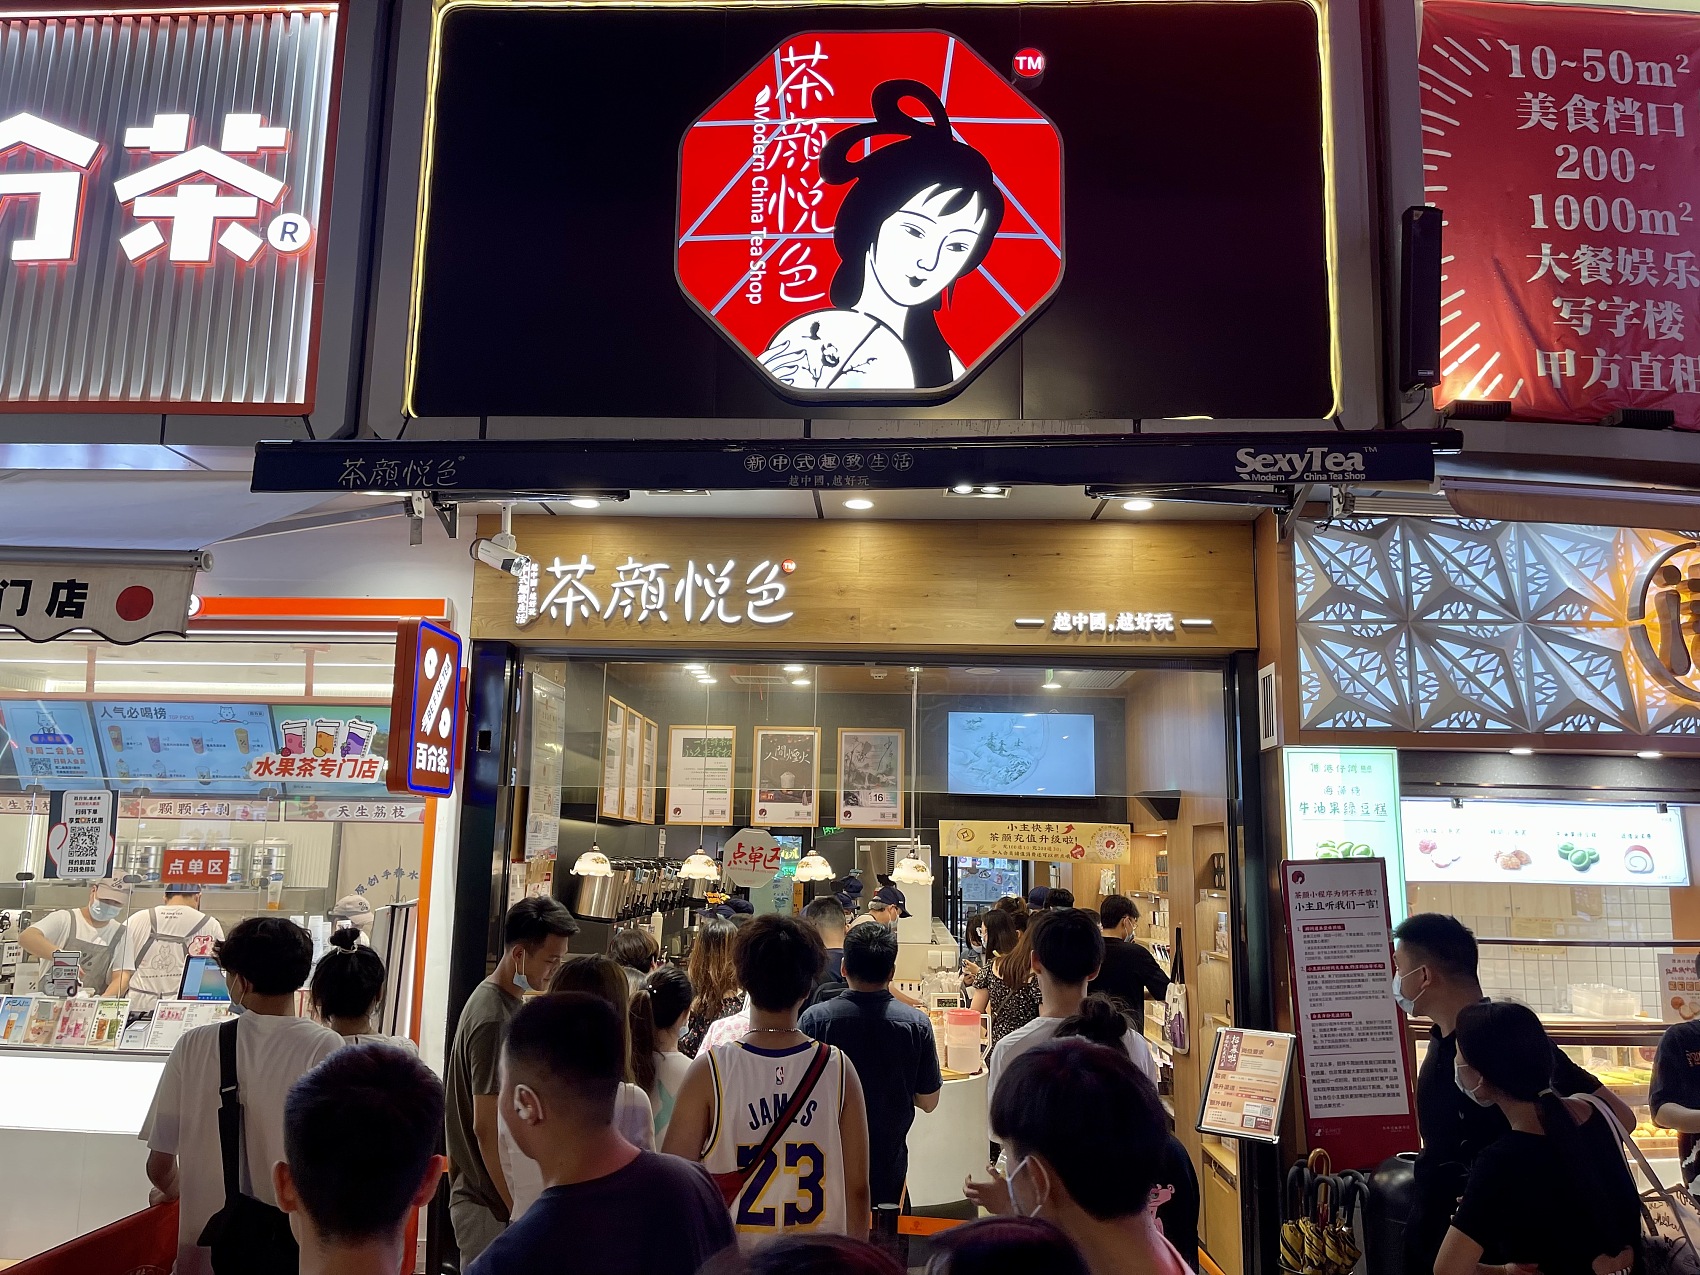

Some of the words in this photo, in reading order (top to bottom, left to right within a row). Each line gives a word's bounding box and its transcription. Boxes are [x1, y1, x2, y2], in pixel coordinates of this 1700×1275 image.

[1014, 55, 1044, 71] TM
[1516, 91, 1685, 138] 美食档口
[752, 106, 770, 172] Modern
[1555, 144, 1656, 183] 200~
[751, 176, 768, 224] China
[750, 227, 767, 257] Tea
[745, 259, 766, 304] Shop
[1526, 243, 1700, 290] 大餐娱乐
[1552, 296, 1685, 342] 写字楼
[1536, 348, 1700, 395] 甲方直租
[744, 452, 914, 473] 新中式趣致生活
[1252, 473, 1285, 482] Modern
[1303, 472, 1328, 481] China
[1328, 472, 1343, 480] Tea
[1344, 472, 1366, 481] Shop
[101, 706, 167, 720] 人气必喝榜
[253, 756, 380, 779] 水果茶专门店
[415, 742, 449, 774] 百分茶
[158, 802, 231, 816] 颗颗手剥
[337, 805, 407, 819] 天生荔枝
[873, 794, 884, 802] 16
[1007, 823, 1059, 833] 小主快来!
[168, 859, 223, 875] 点单区
[728, 842, 781, 872] 点单区
[748, 1093, 818, 1131] JAMS
[735, 1140, 828, 1234] 23
